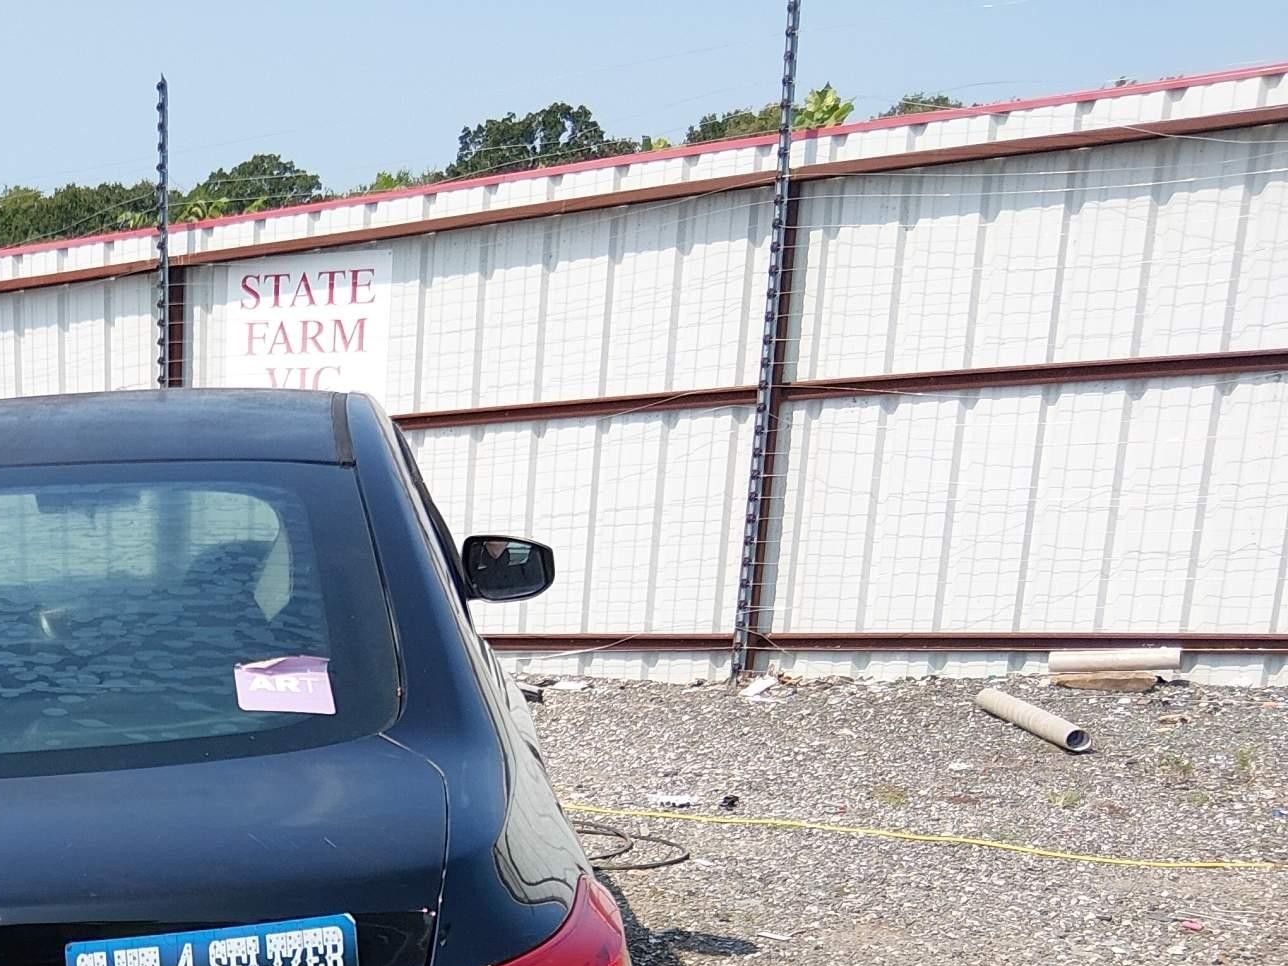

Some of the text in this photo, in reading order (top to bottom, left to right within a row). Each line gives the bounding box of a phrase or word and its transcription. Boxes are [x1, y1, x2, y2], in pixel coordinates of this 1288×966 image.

[240, 268, 376, 310] STATE
[244, 317, 368, 356] FARM
[248, 675, 319, 694] ART
